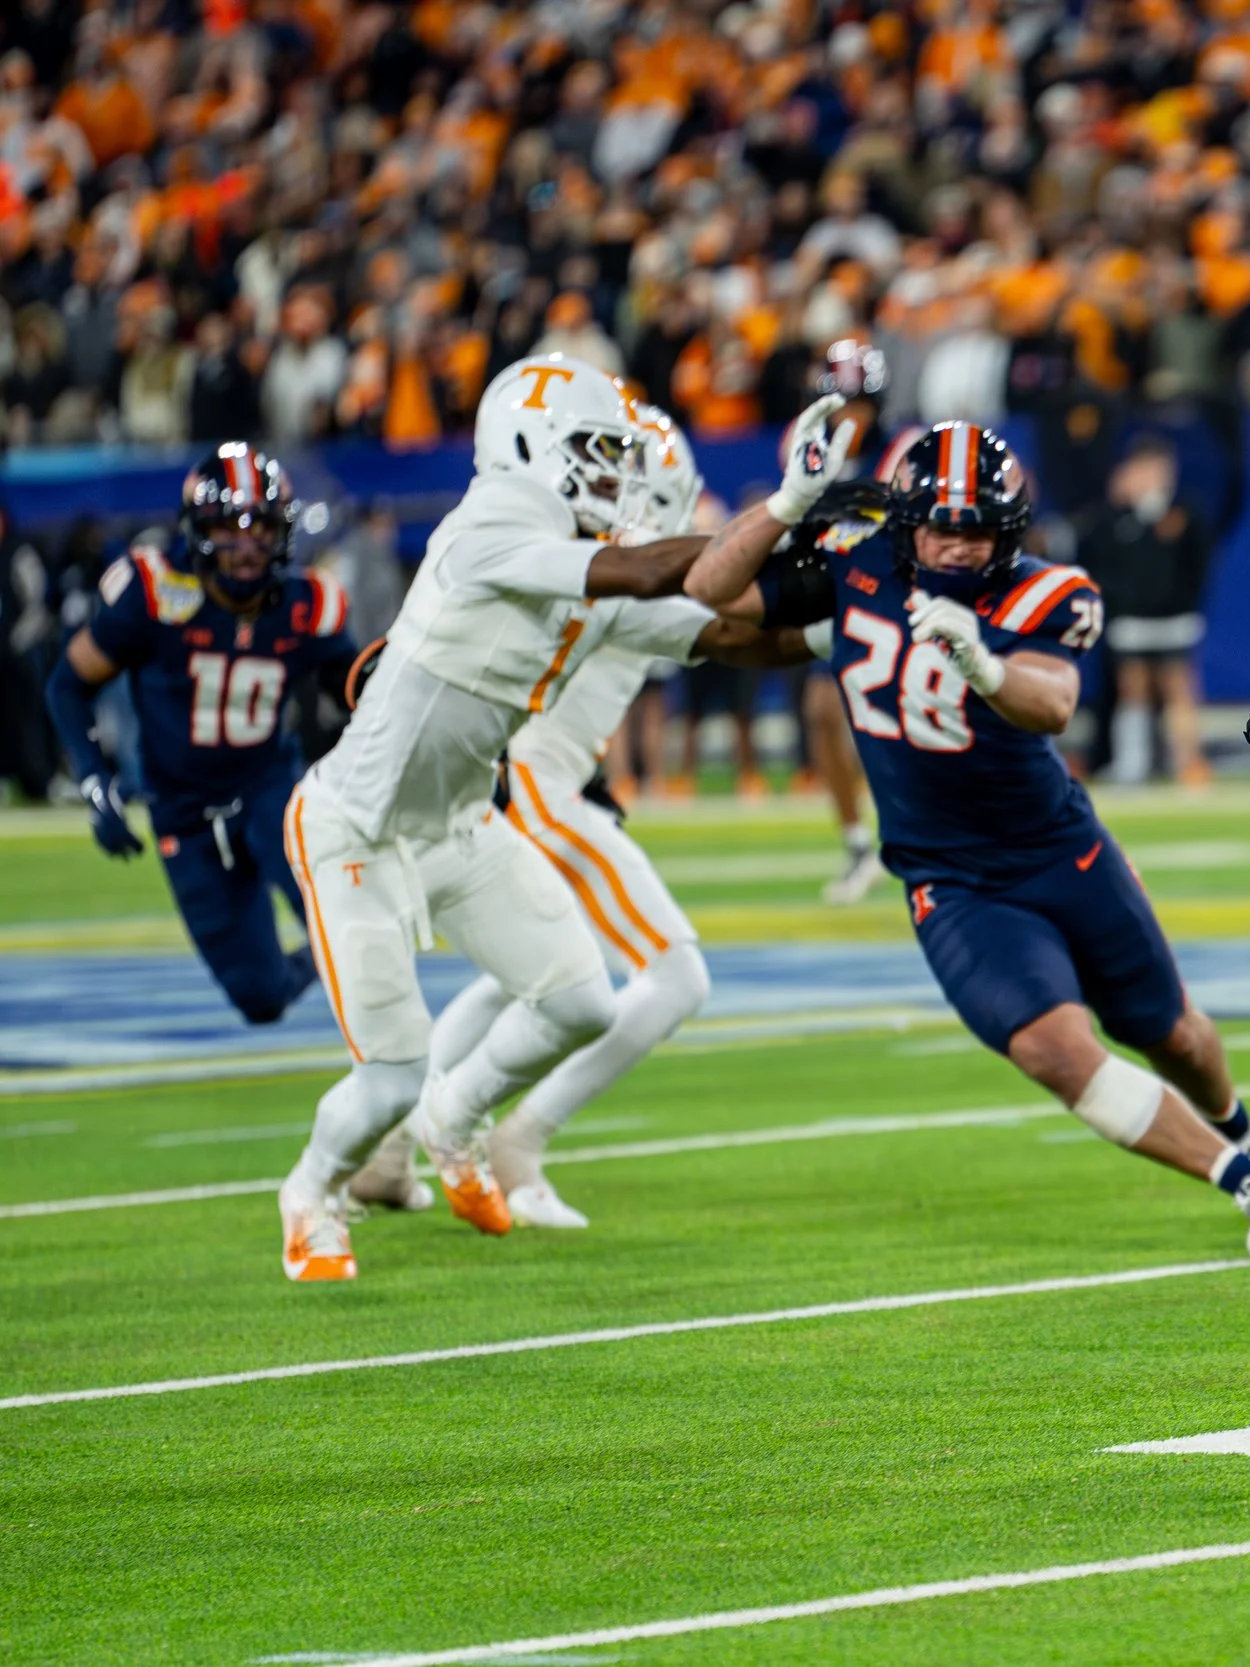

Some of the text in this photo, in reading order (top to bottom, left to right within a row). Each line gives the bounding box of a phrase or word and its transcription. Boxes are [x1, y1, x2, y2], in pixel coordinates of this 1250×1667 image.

[521, 366, 574, 409] T
[189, 651, 285, 748] 10
[839, 605, 975, 753] 28
[343, 862, 366, 888] T
